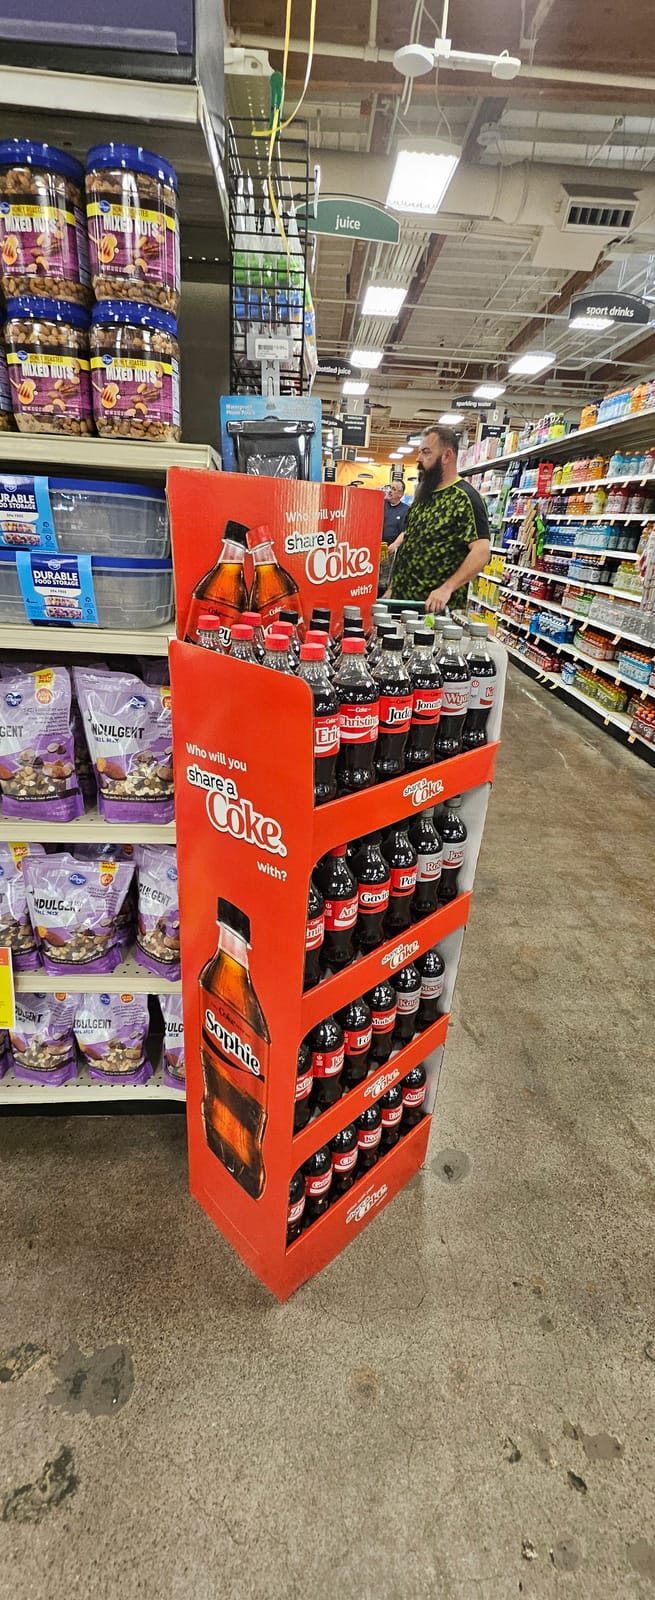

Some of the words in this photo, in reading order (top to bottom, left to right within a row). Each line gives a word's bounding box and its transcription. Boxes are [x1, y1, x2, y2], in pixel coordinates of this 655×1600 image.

[4, 216, 32, 233] MIXED
[33, 217, 58, 234] NUTS
[103, 215, 133, 233] MIXED
[134, 217, 160, 239] NUTS
[335, 214, 361, 231] juice
[586, 306, 608, 316] sport
[609, 306, 635, 317] drinks
[21, 363, 50, 378] MIXED
[50, 364, 75, 380] NUTS
[105, 367, 134, 382] MIXED
[134, 368, 158, 384] NUTS
[338, 367, 352, 375] juice
[353, 399, 359, 412] 7
[493, 409, 499, 421] 6
[286, 511, 309, 522] Who
[311, 508, 328, 520] will
[330, 510, 346, 521] you
[286, 532, 325, 551] share
[326, 532, 337, 546] a
[33, 570, 79, 582] DURABLE
[350, 584, 373, 597] with?
[0, 725, 23, 738] GENT
[186, 742, 207, 759] Who
[208, 752, 227, 766] will
[228, 758, 247, 774] you
[188, 766, 225, 792] share
[226, 780, 237, 797] a
[256, 860, 287, 882] with?
[205, 1008, 260, 1076] Sophie
